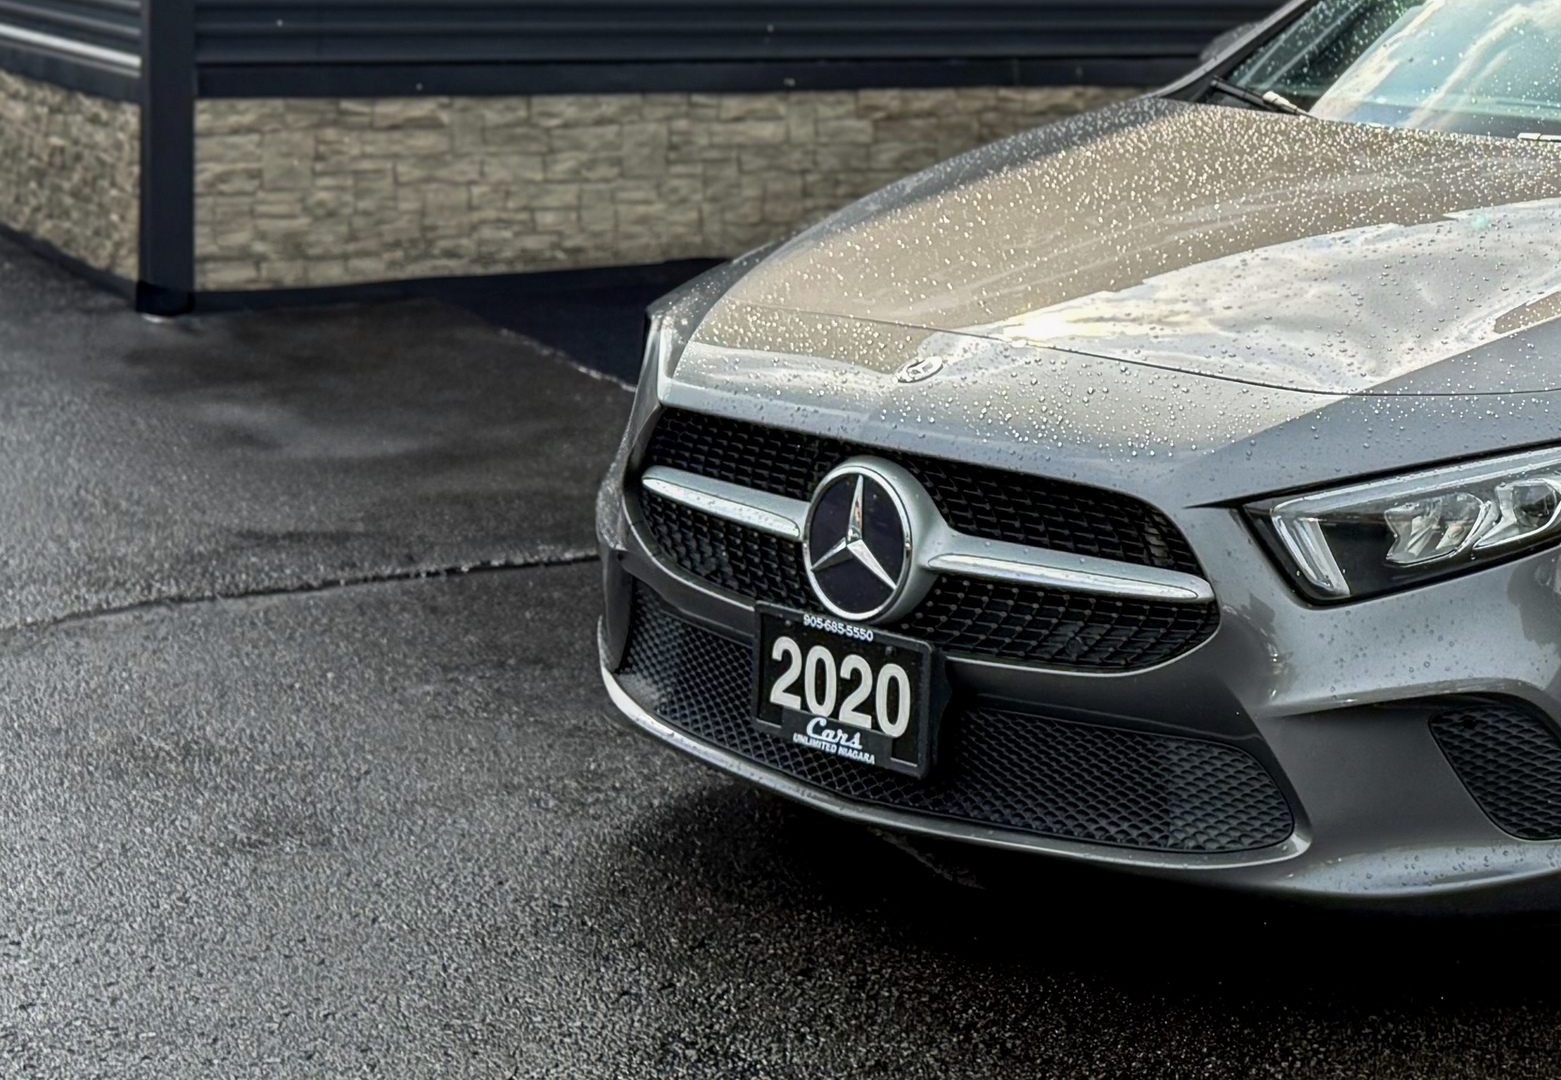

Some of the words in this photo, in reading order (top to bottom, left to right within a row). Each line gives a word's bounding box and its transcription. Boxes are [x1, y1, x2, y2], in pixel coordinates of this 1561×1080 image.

[803, 614, 874, 642] 905-685-5550
[770, 636, 911, 738] 2020
[792, 733, 837, 753] UNLIMITED
[837, 745, 876, 765] NIAGARA
[806, 717, 863, 749] Cars
